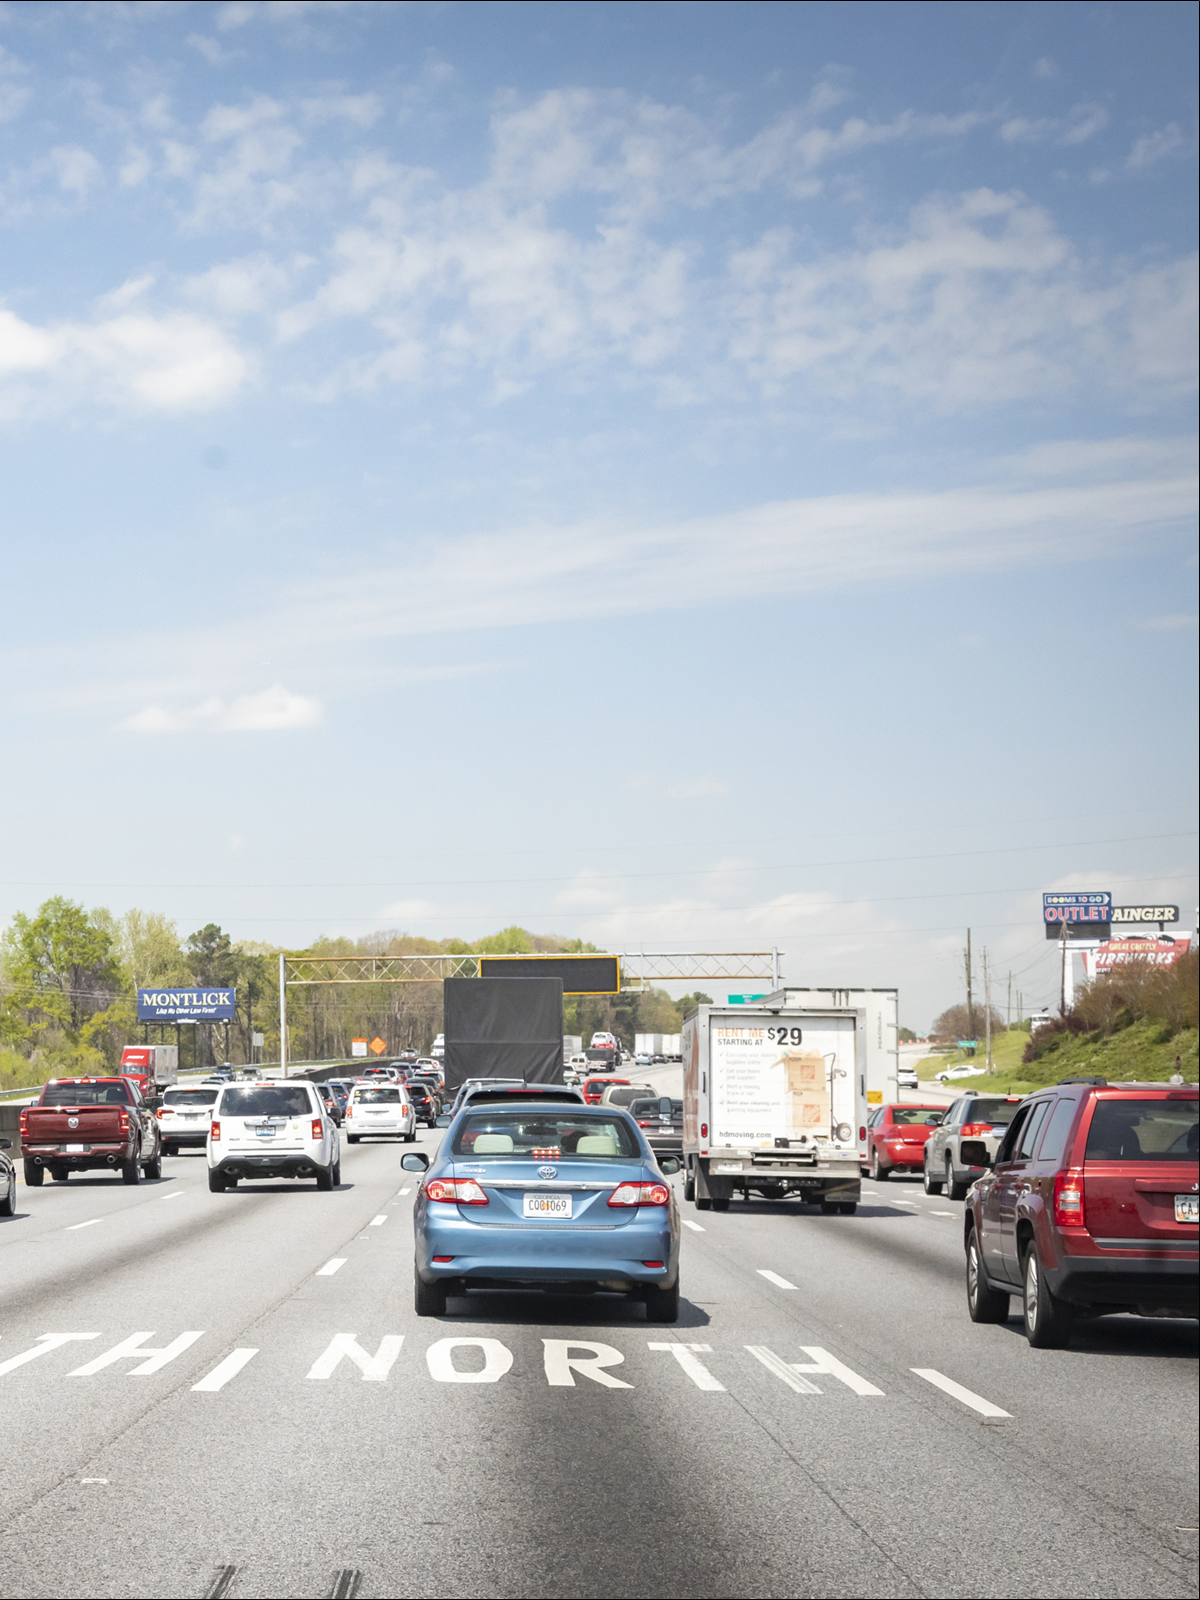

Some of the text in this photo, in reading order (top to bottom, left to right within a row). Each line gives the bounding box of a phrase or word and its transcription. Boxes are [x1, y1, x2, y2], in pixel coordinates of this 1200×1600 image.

[1045, 906, 1109, 921] OUTLET
[1111, 907, 1176, 921] AINGER
[1108, 943, 1129, 951] GREAT
[142, 992, 231, 1006] MONTLICK
[718, 1027, 803, 1046] RENT ME $29
[719, 1131, 771, 1139] hdmoving.com
[305, 1333, 886, 1396] NORTH
